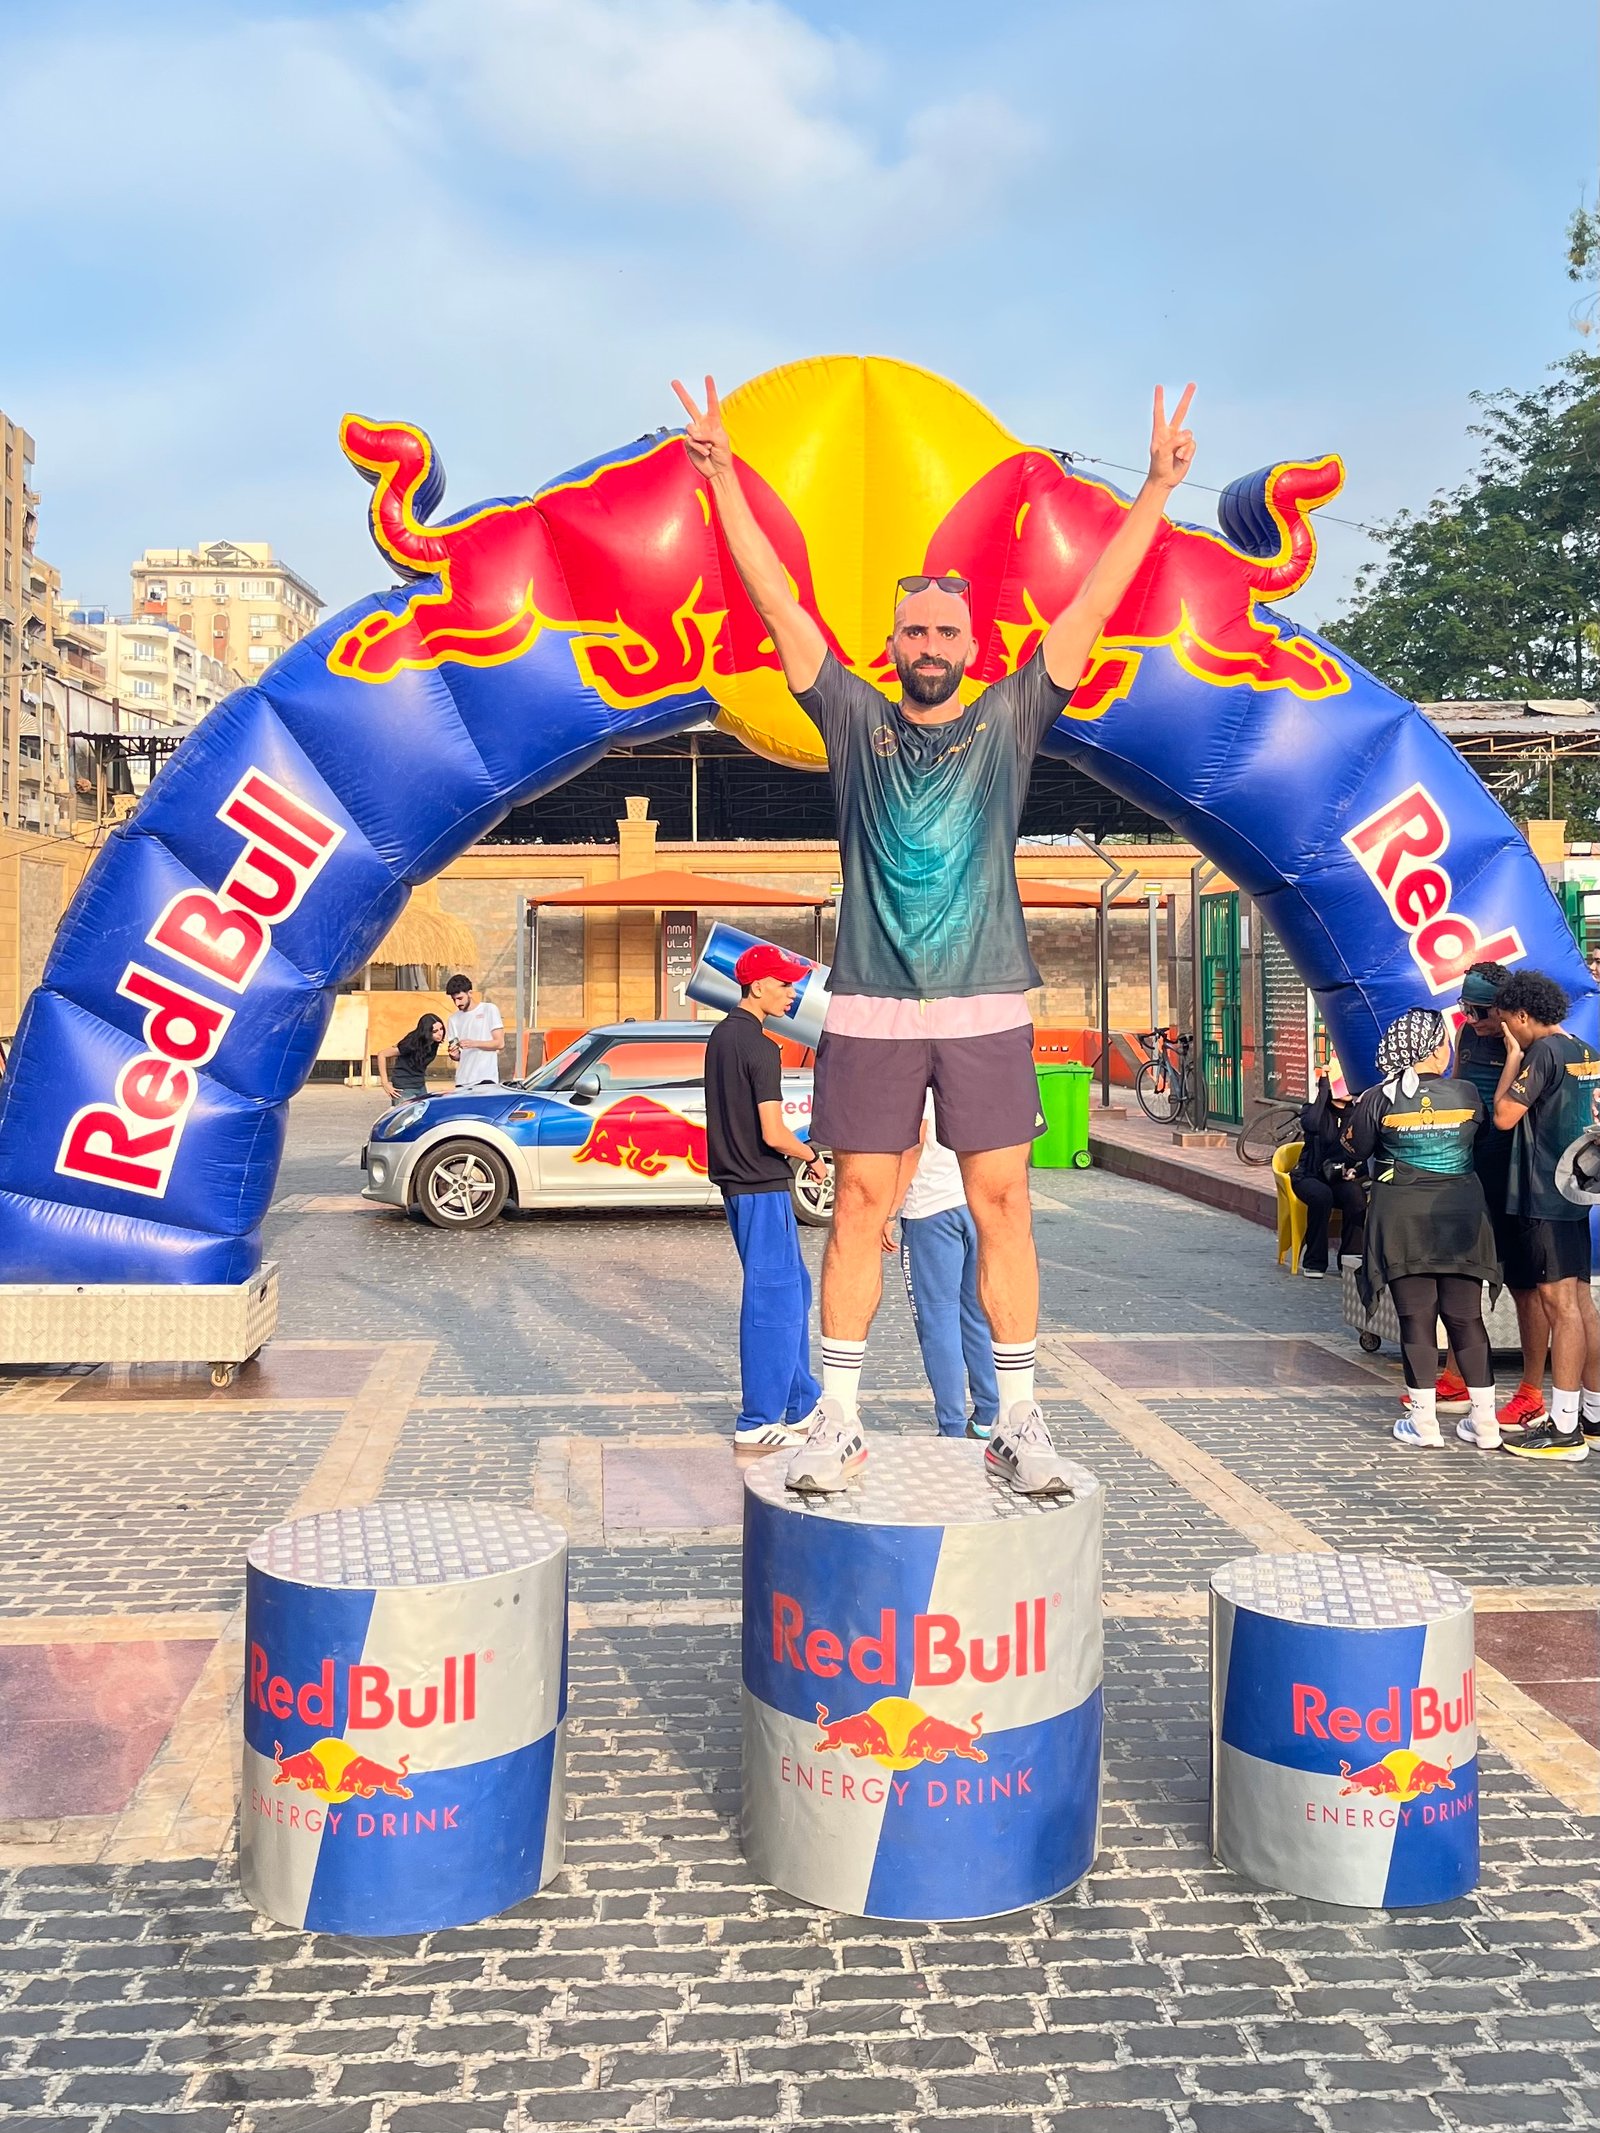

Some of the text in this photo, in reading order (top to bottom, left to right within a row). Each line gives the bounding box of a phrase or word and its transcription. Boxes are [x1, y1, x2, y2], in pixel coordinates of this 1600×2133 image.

[1347, 787, 1522, 991] Red
[666, 925, 692, 935] AMAN
[60, 771, 340, 1194] Red Bull
[673, 981, 686, 1006] 1
[783, 1094, 812, 1115] ed
[903, 1244, 913, 1291] AMERICAN
[772, 1592, 1048, 1687] Red Bull
[250, 1640, 477, 1731] Red Bull
[1292, 1669, 1474, 1743] Red Bull
[781, 1756, 1034, 1808] ENERGY DRINK
[252, 1787, 460, 1838] ENERGY DRINK
[1306, 1791, 1475, 1828] ENERGY DRINK
